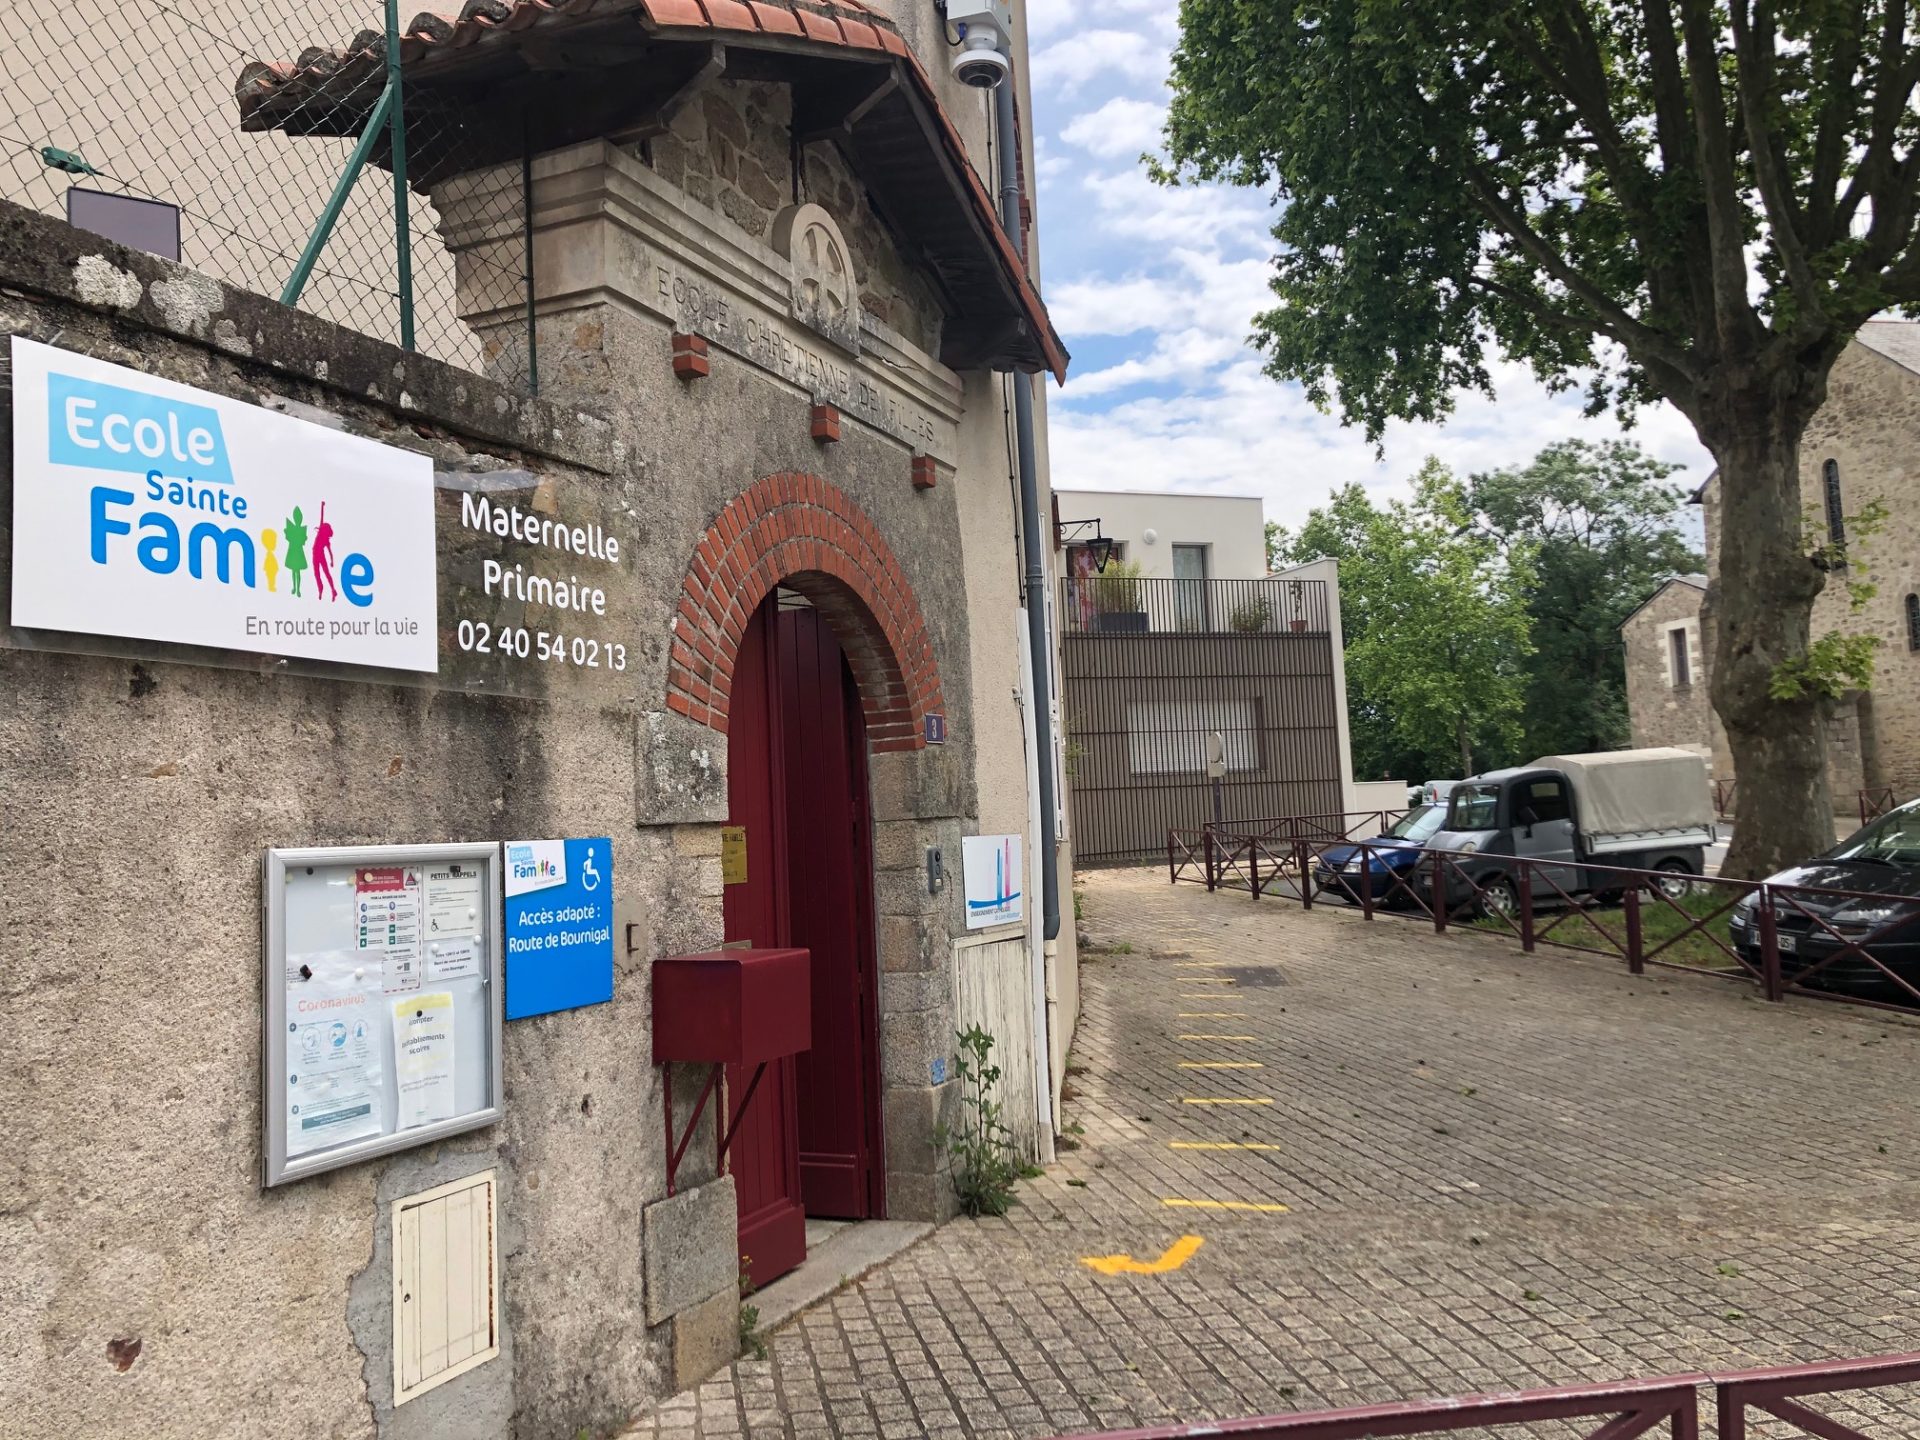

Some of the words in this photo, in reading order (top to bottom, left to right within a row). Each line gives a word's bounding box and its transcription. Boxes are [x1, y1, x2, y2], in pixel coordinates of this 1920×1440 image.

[656, 266, 729, 329] ECOLE
[859, 382, 878, 411] DE
[65, 396, 215, 466] Ecole
[146, 469, 247, 519] Sainte
[461, 491, 619, 563] Maternelle
[483, 559, 606, 616] Primaire
[246, 616, 270, 635] En
[275, 617, 325, 635] route
[330, 620, 370, 640] pour
[374, 617, 390, 635] la
[394, 617, 418, 635] vie
[458, 619, 491, 653] 02
[498, 626, 530, 658] 40
[537, 631, 566, 663] 54
[571, 637, 599, 667] 02
[604, 642, 626, 671] 13
[931, 718, 937, 739] 3
[430, 872, 450, 880] PETITS
[519, 907, 554, 927] Accès
[556, 903, 595, 924] adapté
[509, 936, 543, 953] Route
[544, 932, 559, 948] de
[560, 925, 610, 947] Bournigal
[298, 993, 366, 1013] Coronavirus
